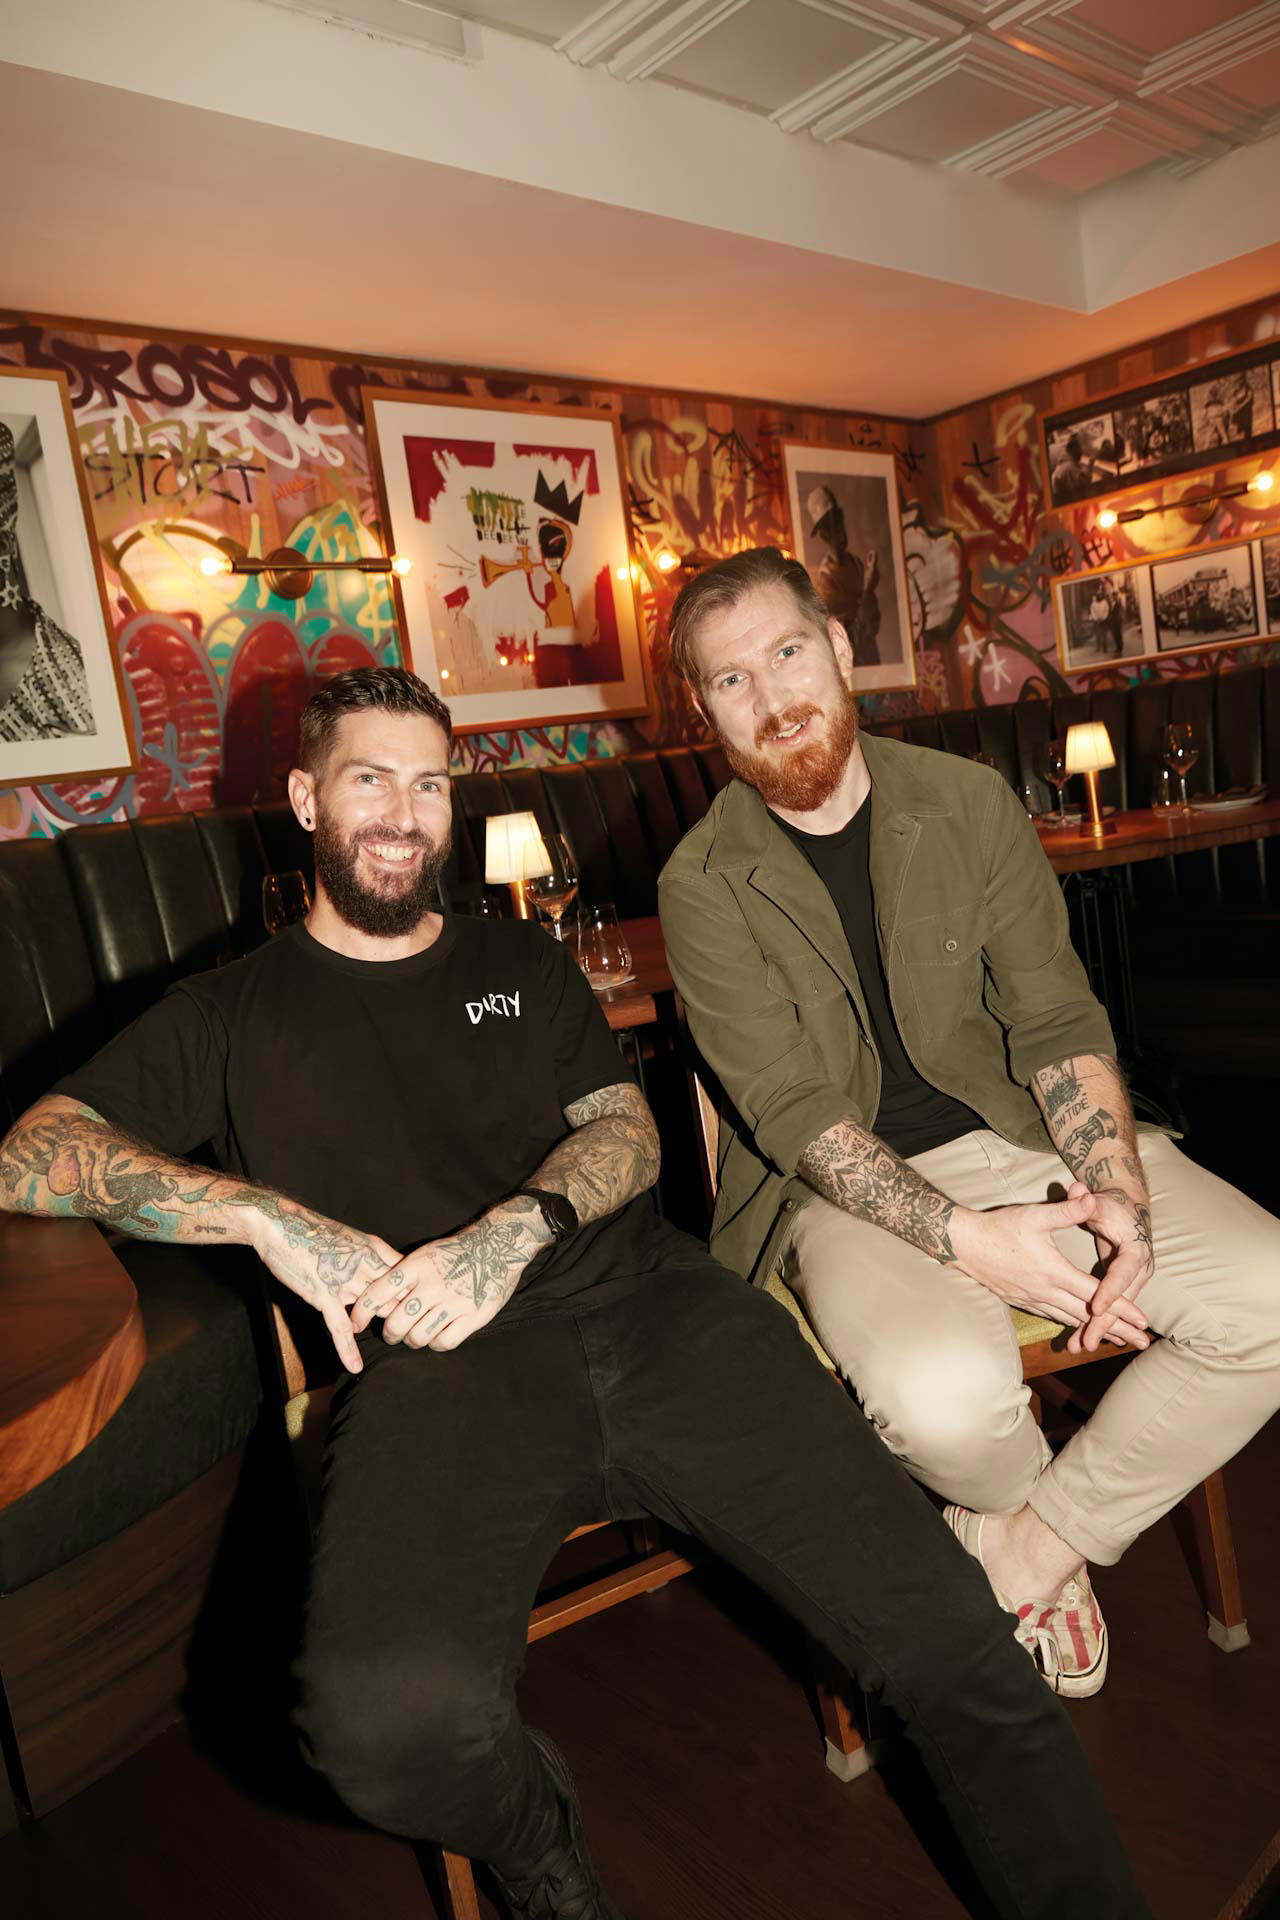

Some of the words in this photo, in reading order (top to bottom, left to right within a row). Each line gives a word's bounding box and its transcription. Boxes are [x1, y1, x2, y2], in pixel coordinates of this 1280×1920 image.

[465, 990, 520, 1024] DIRTY
[1052, 1114, 1066, 1138] LOW
[1065, 1097, 1089, 1120] TIDE
